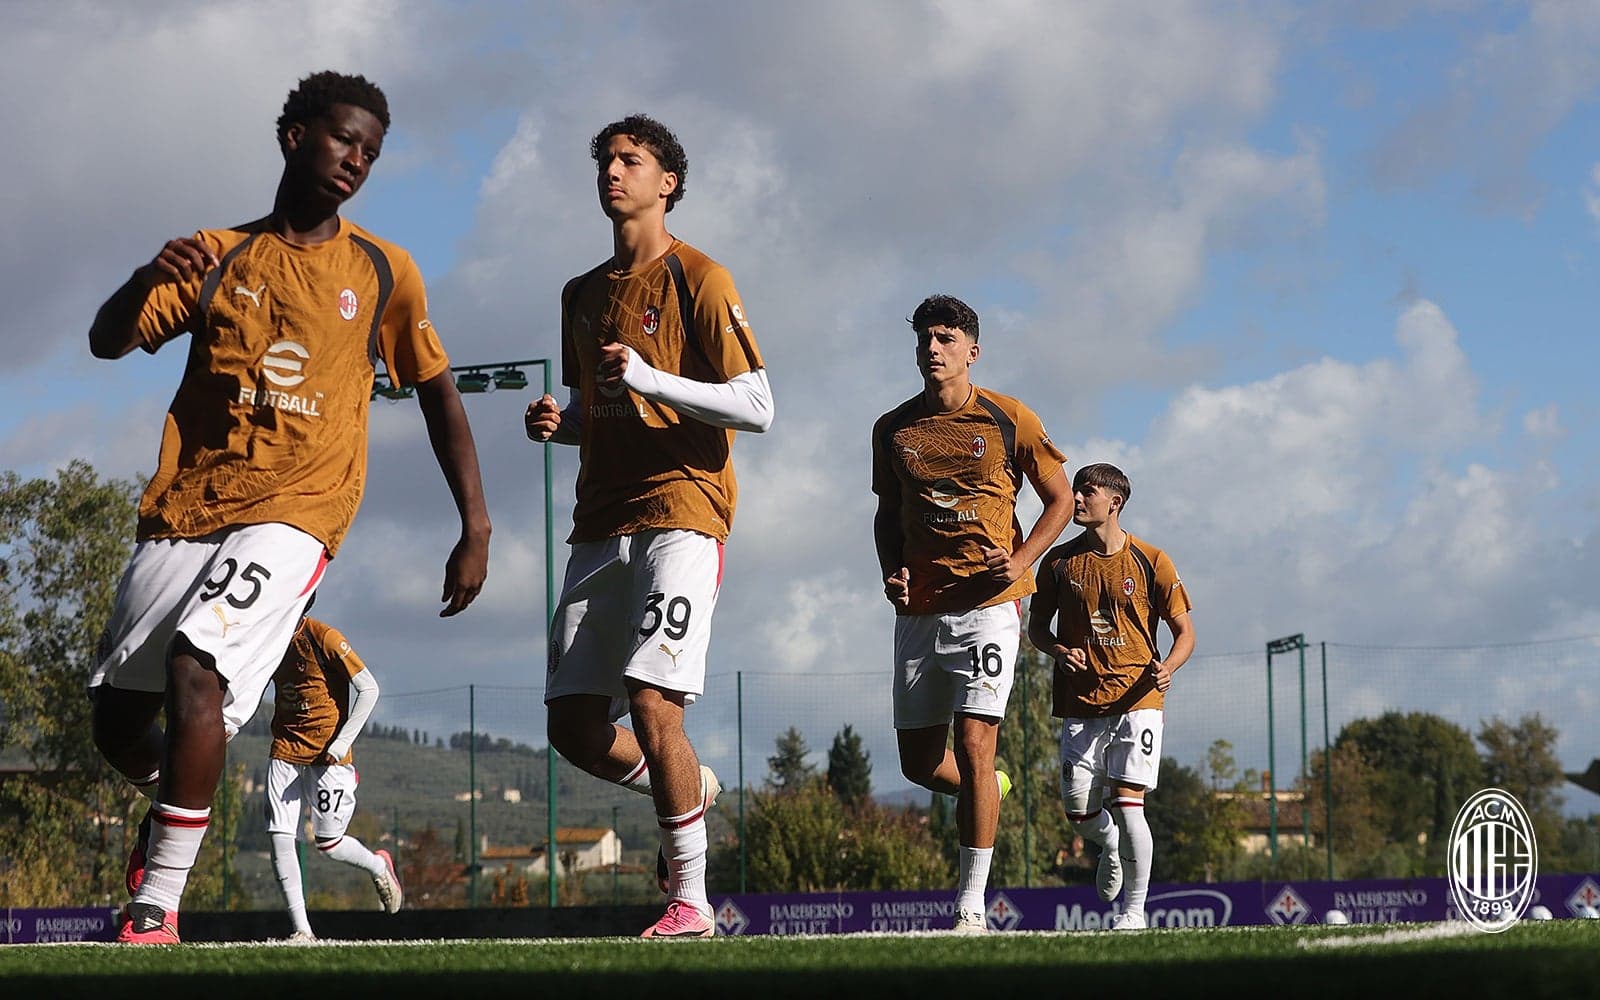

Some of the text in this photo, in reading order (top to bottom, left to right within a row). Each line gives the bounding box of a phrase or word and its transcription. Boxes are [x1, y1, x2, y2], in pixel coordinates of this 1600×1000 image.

[590, 403, 649, 418] OOTBAL
[200, 557, 271, 609] 95
[637, 592, 692, 640] 39
[1140, 727, 1154, 756] 9
[317, 788, 344, 813] 87
[769, 902, 854, 920] BARBERINO
[871, 901, 955, 918] BARBERINO
[1054, 903, 1216, 931] Medcom
